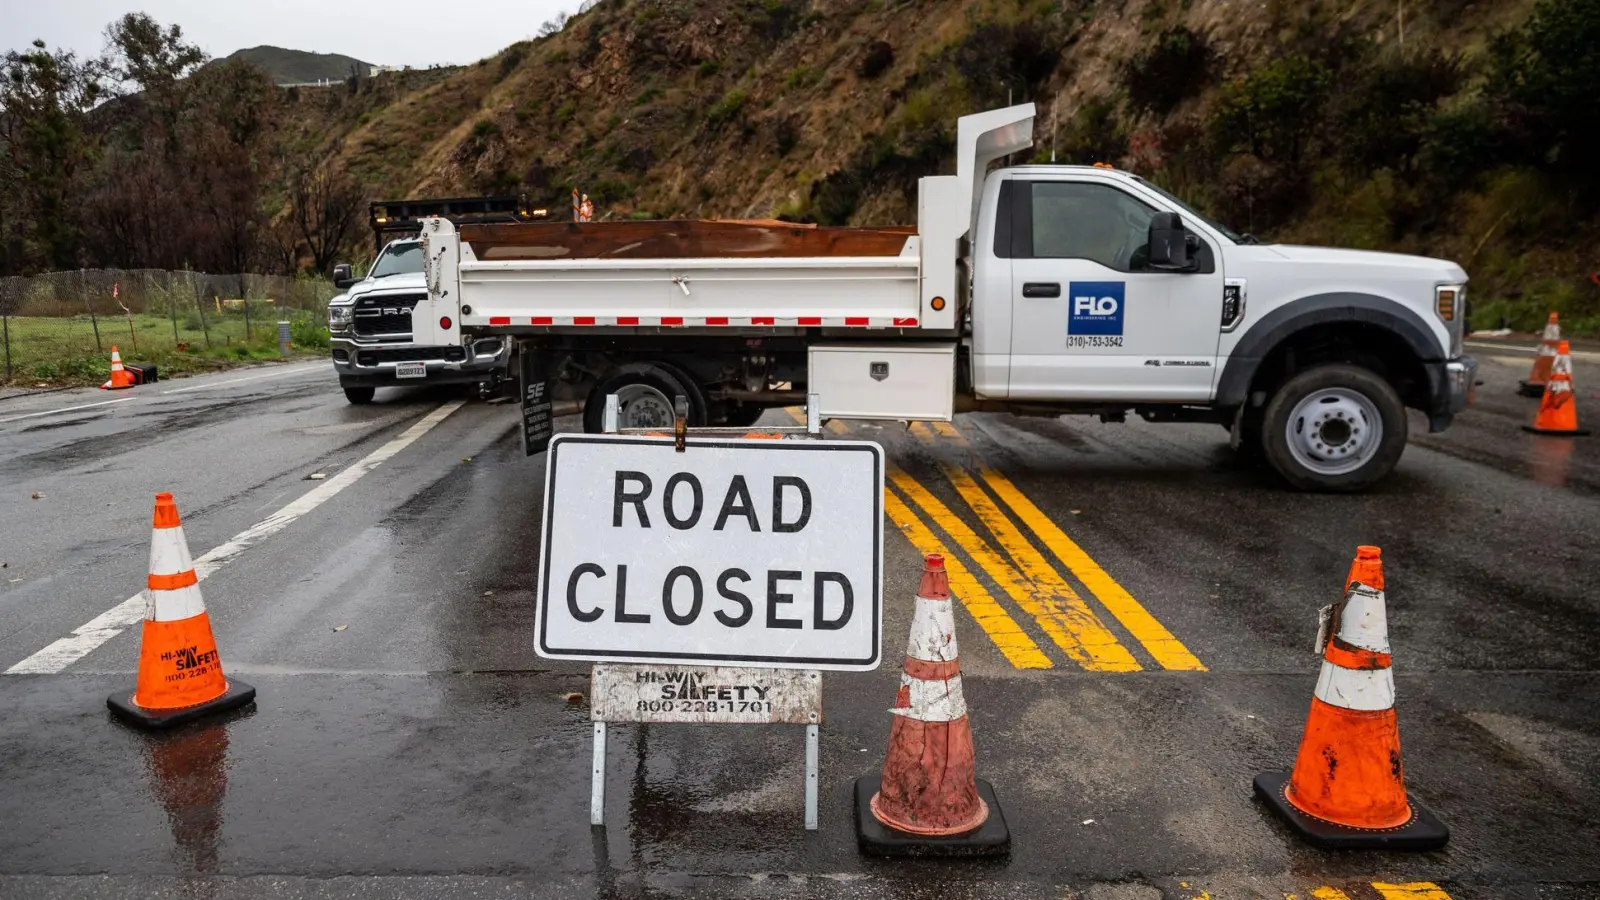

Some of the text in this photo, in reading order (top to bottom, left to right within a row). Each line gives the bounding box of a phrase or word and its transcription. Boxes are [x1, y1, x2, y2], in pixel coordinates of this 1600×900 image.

[383, 307, 413, 315] RA
[1074, 296, 1118, 316] FLO
[1066, 336, 1123, 349] (310)-753-3542
[526, 381, 546, 400] SE
[612, 470, 812, 533] ROAD
[566, 562, 854, 631] CLOSED
[660, 685, 772, 701] SAFETY
